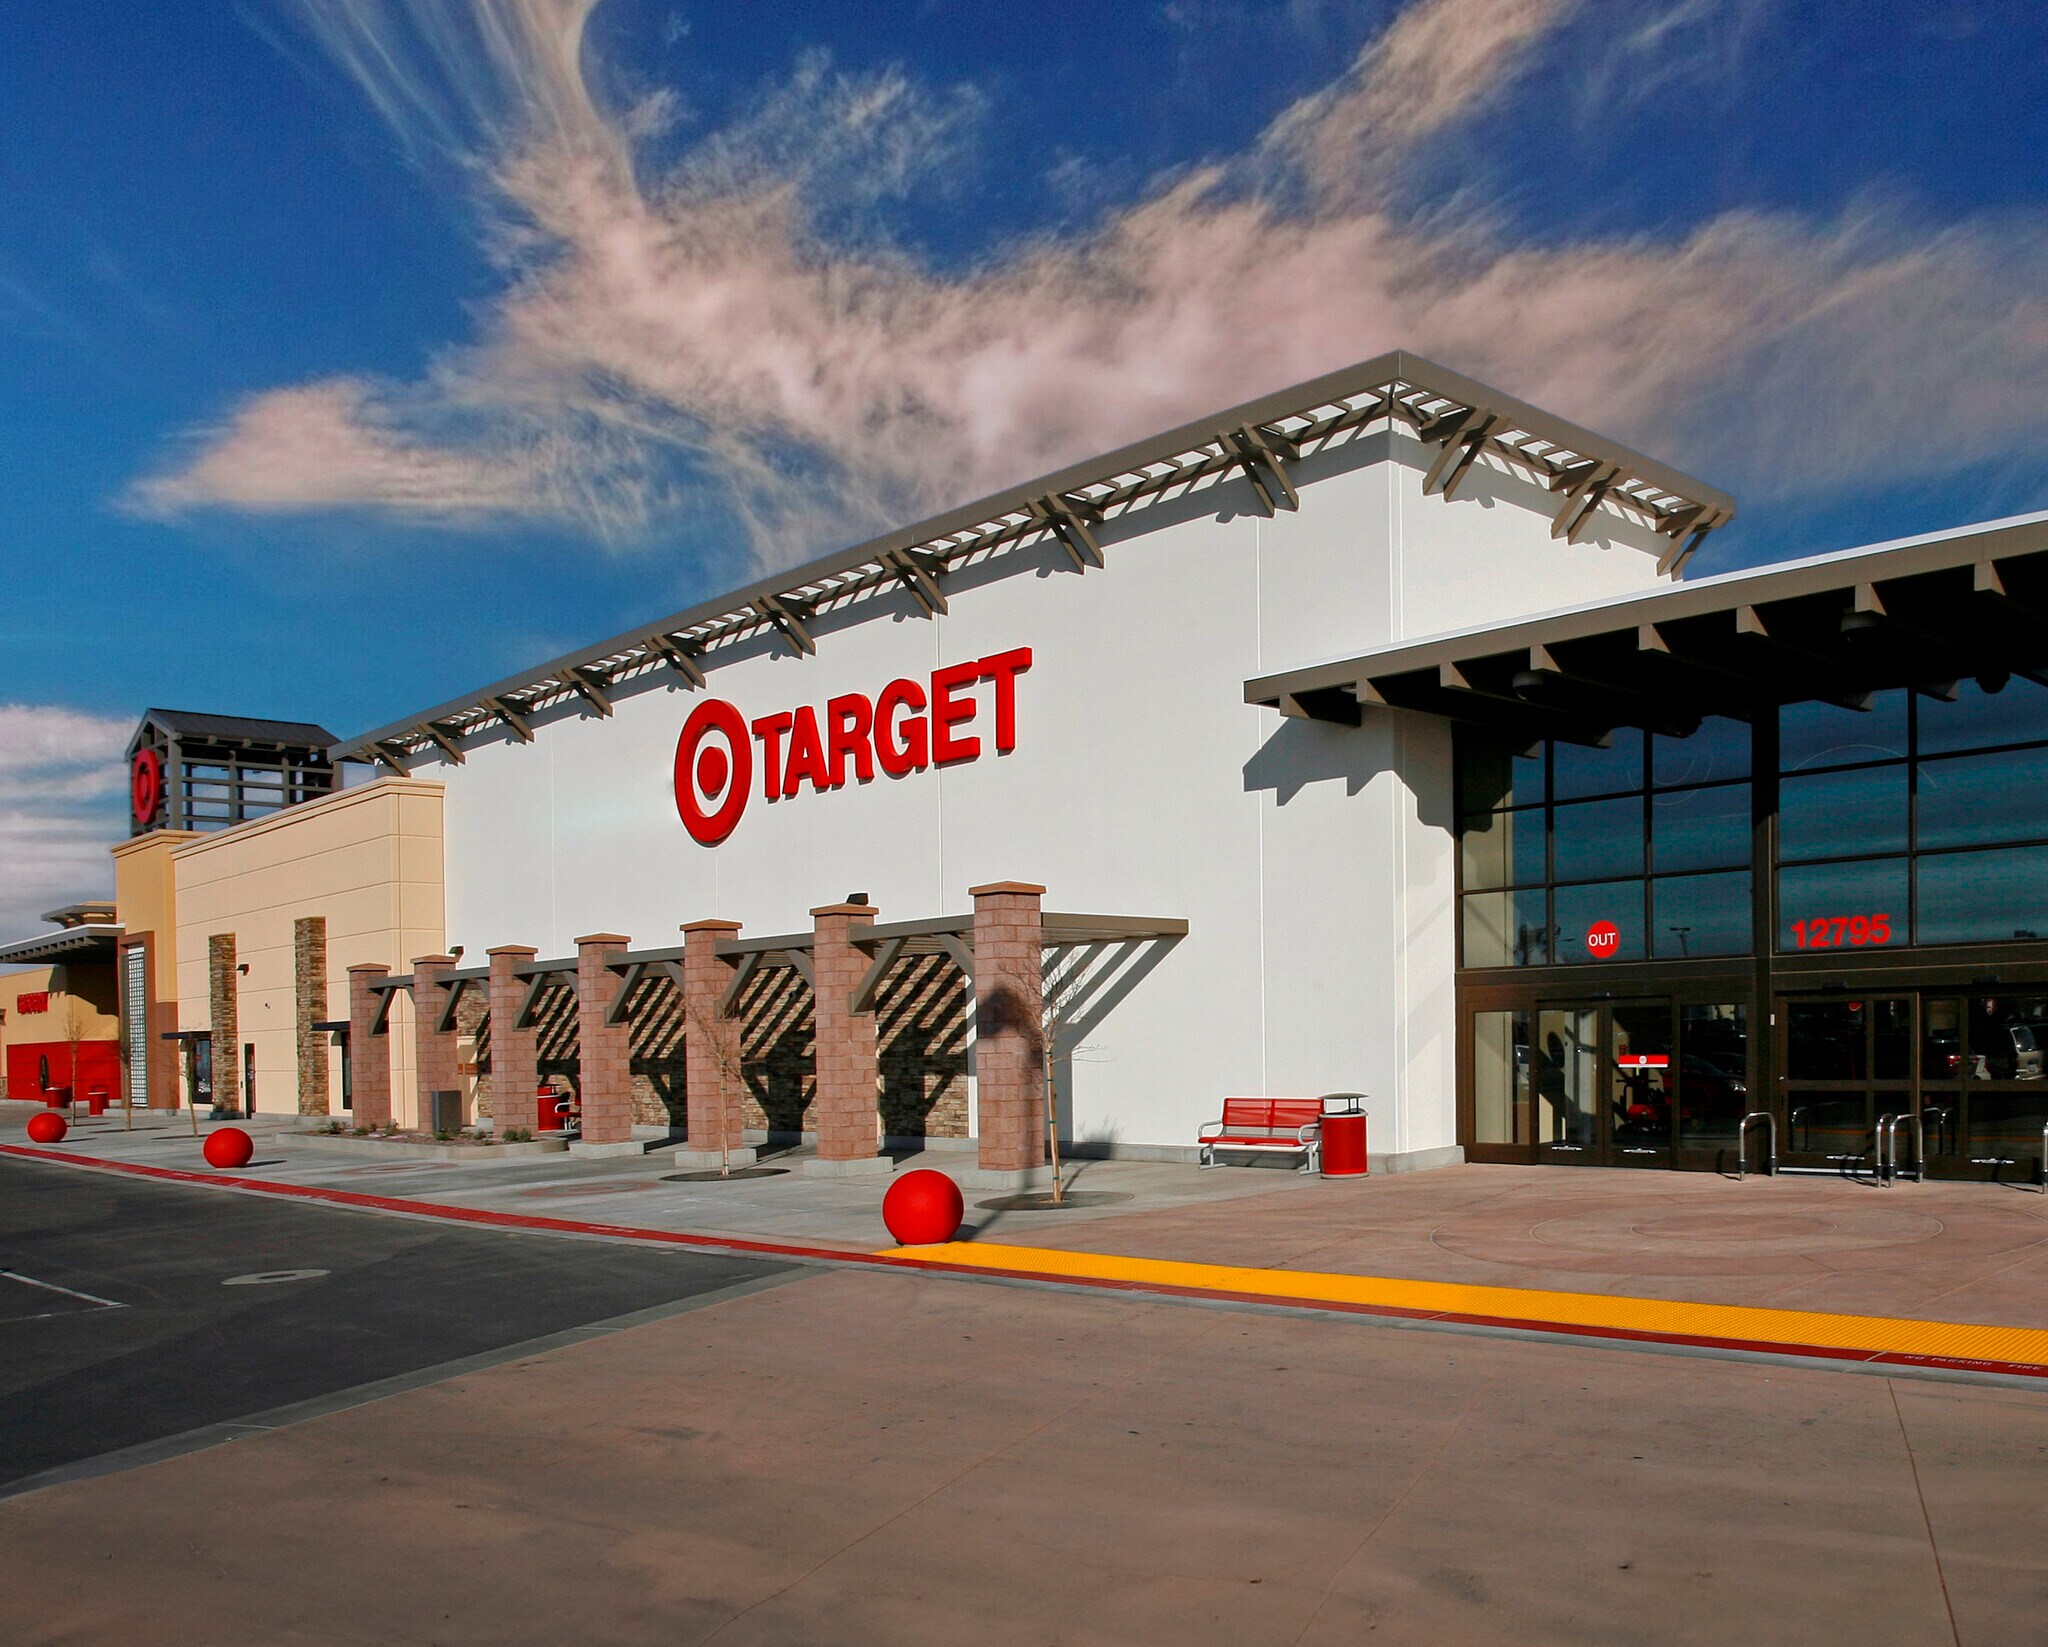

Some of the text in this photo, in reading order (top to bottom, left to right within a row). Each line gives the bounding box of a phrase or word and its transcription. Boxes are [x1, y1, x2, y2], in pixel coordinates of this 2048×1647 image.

[752, 647, 1033, 800] TARGET
[1588, 932, 1616, 947] OUT
[1791, 913, 1891, 948] 12795
[1931, 1357, 1993, 1366] PARKING
